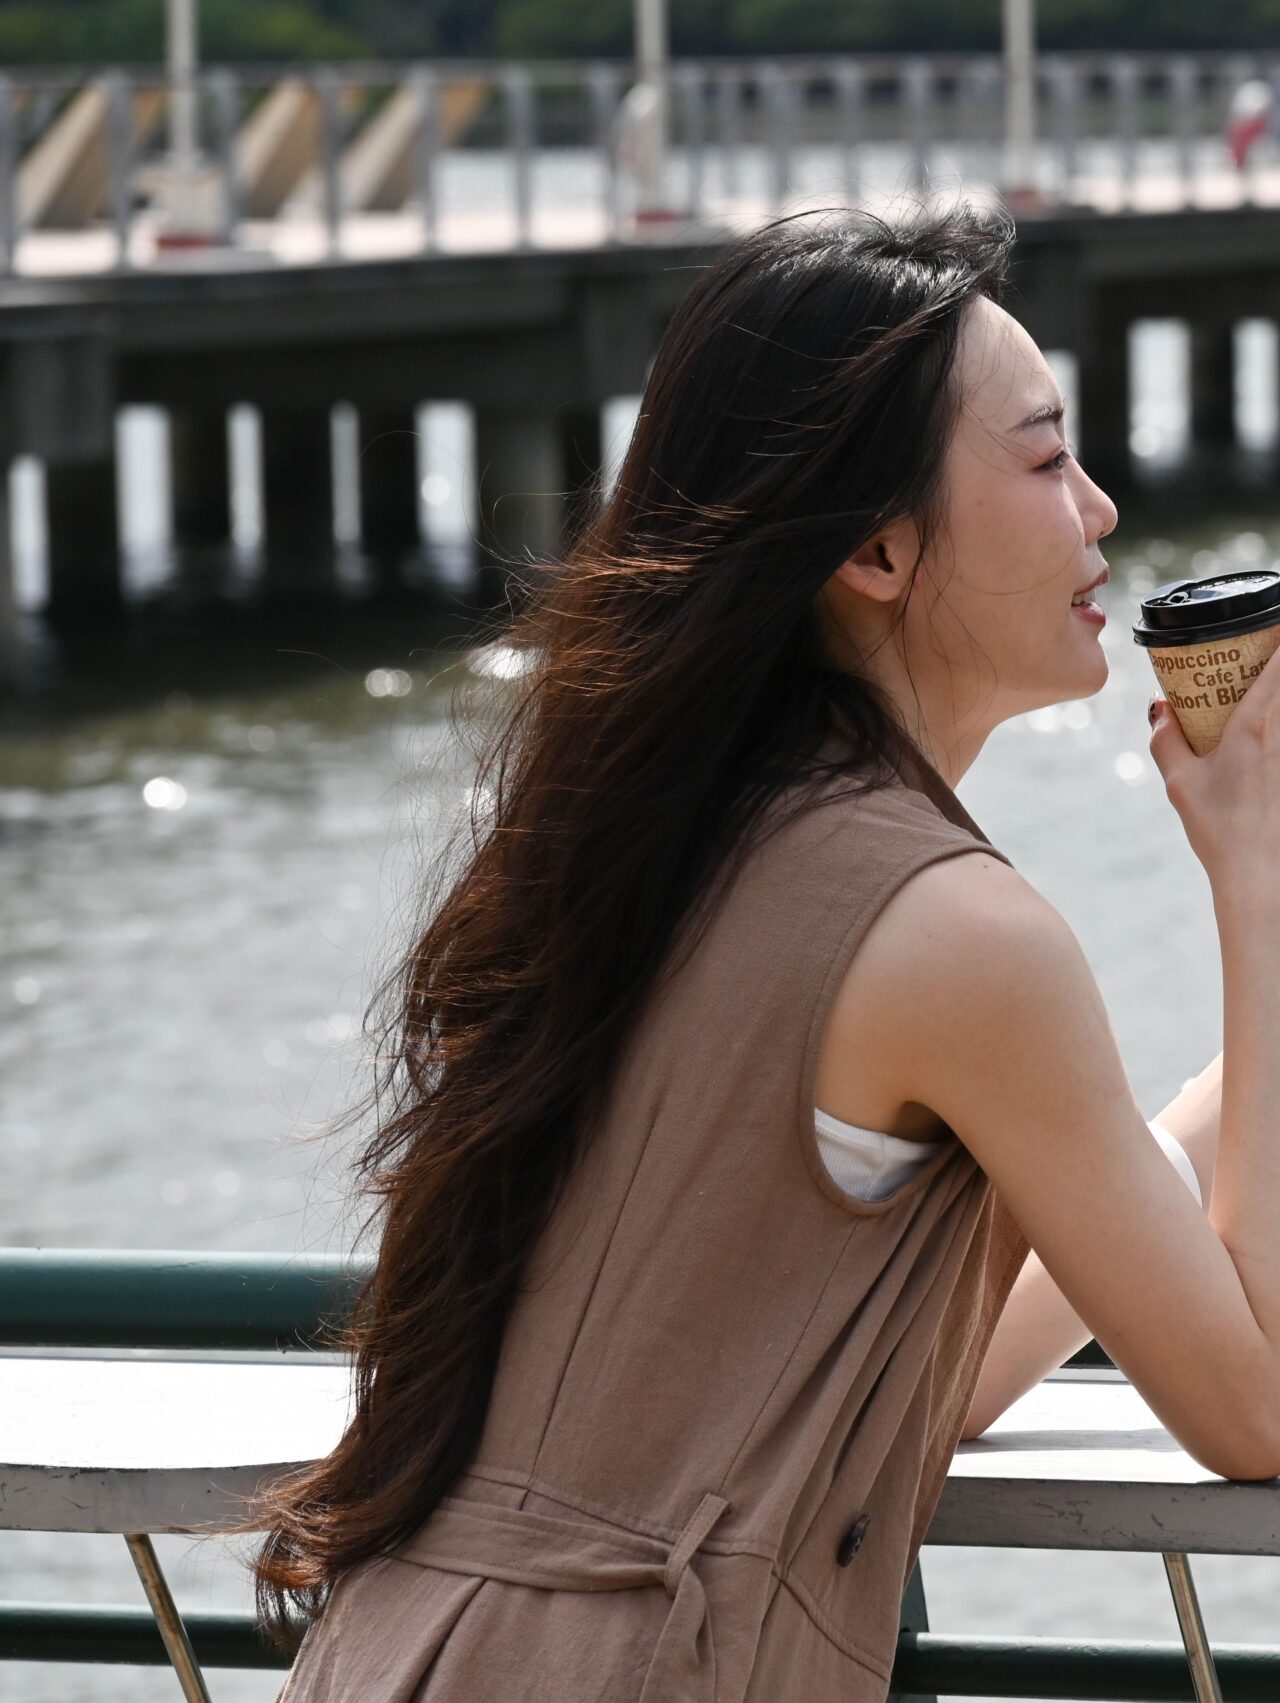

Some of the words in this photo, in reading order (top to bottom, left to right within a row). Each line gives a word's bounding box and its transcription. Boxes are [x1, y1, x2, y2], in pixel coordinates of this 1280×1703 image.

[1152, 648, 1241, 675] appuccino
[1193, 668, 1234, 687] Cafe
[1168, 690, 1212, 709] Short
[1216, 685, 1248, 706] Bla
